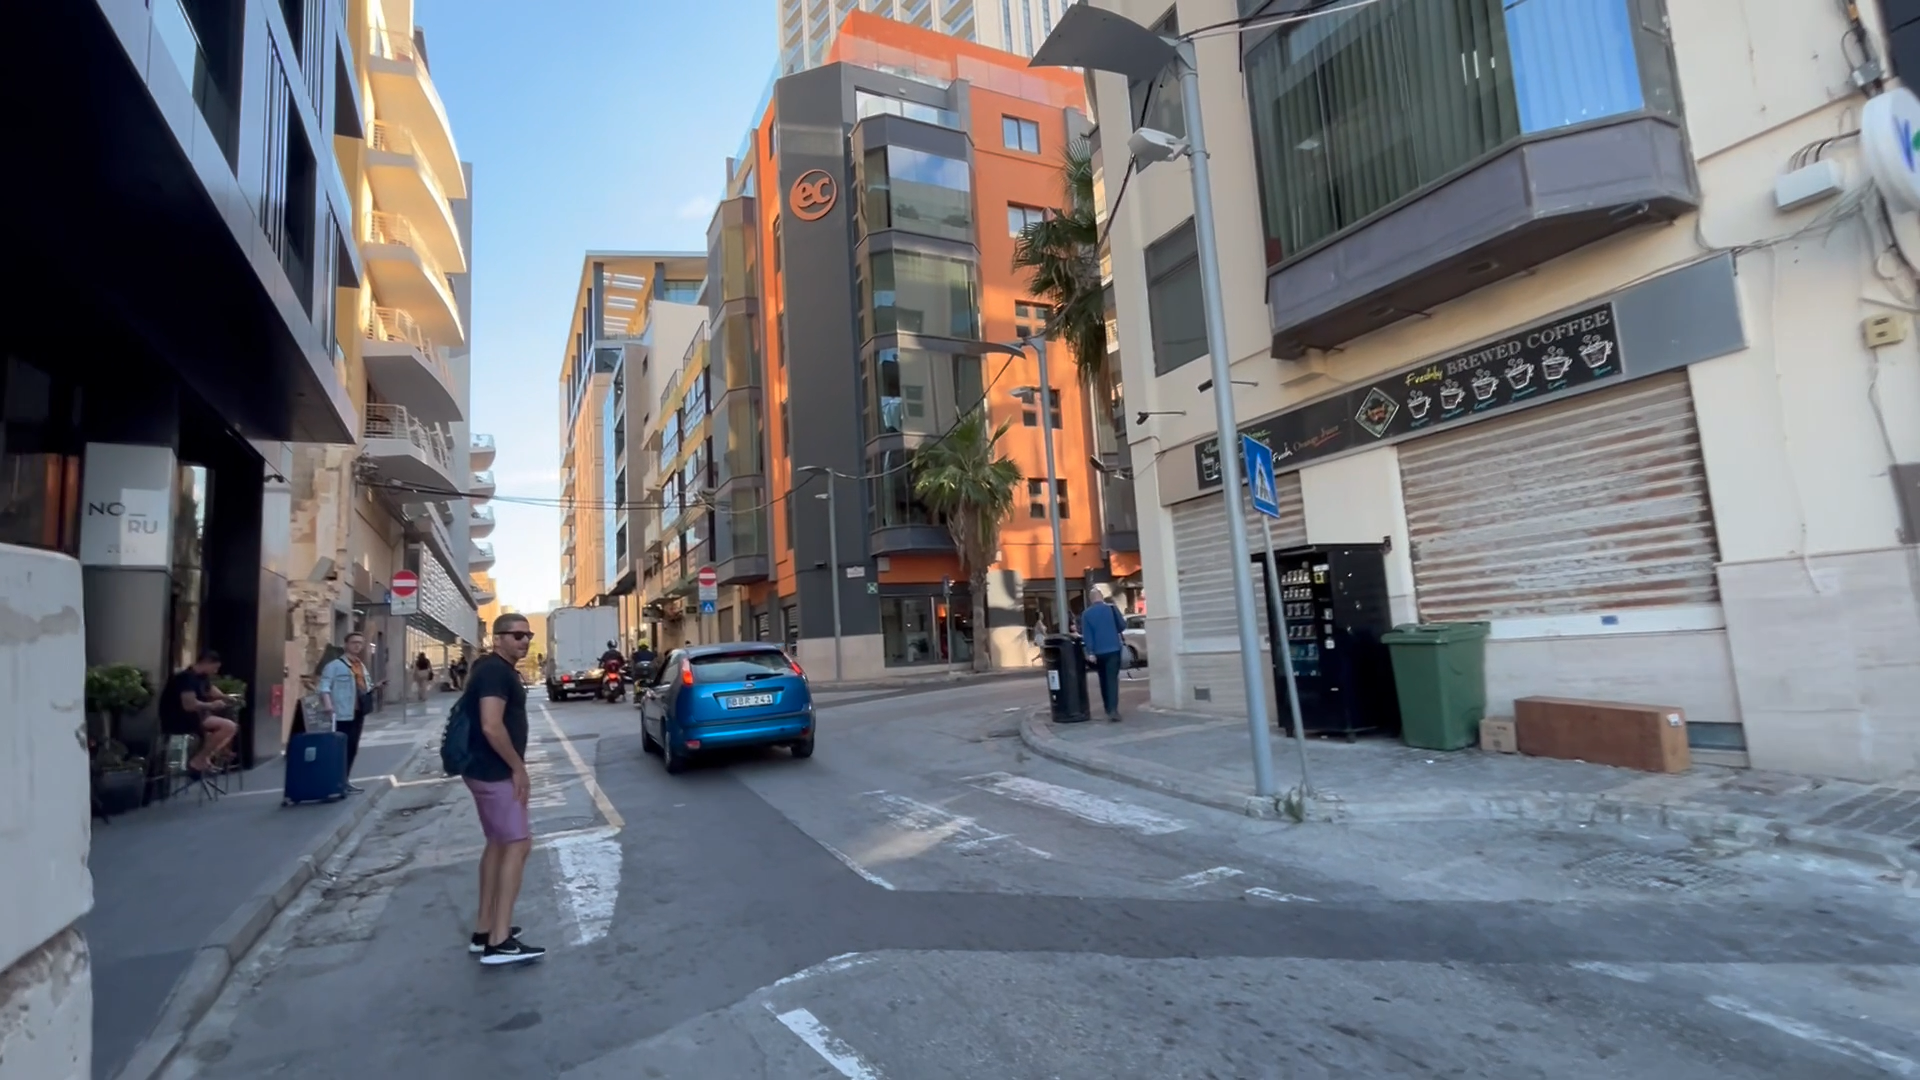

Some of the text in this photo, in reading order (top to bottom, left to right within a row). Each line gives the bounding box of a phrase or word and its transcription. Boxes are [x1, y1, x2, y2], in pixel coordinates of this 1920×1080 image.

[1405, 310, 1610, 386] Freshly BREWED COFFEE
[128, 520, 158, 534] RU
